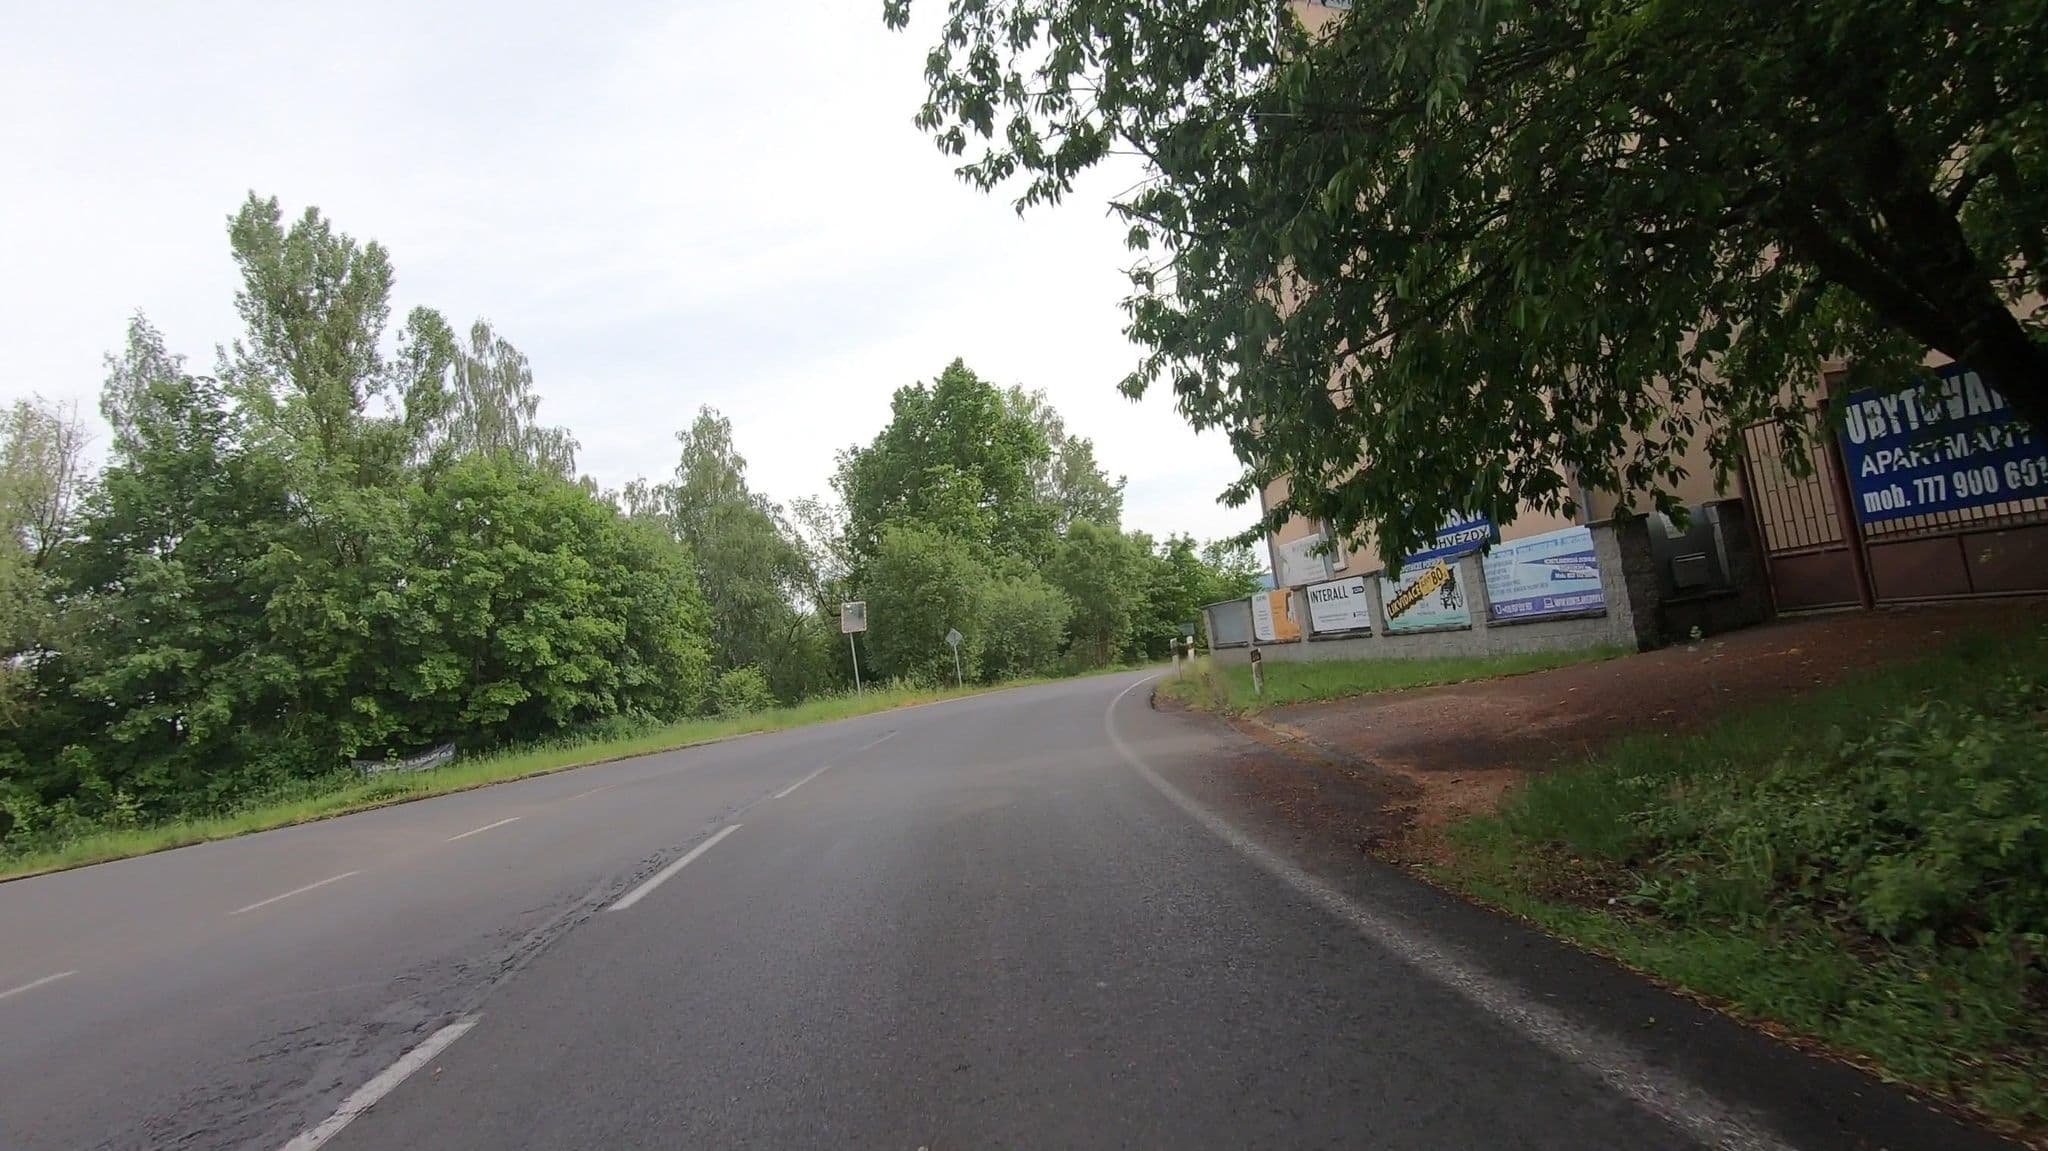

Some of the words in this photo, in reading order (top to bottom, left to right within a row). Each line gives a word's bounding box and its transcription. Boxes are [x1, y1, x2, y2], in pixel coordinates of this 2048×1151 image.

[1863, 483, 1912, 513] mob.
[1913, 475, 1947, 504] 777
[1953, 465, 2000, 498] 900
[1310, 585, 1349, 603] INTERALL
